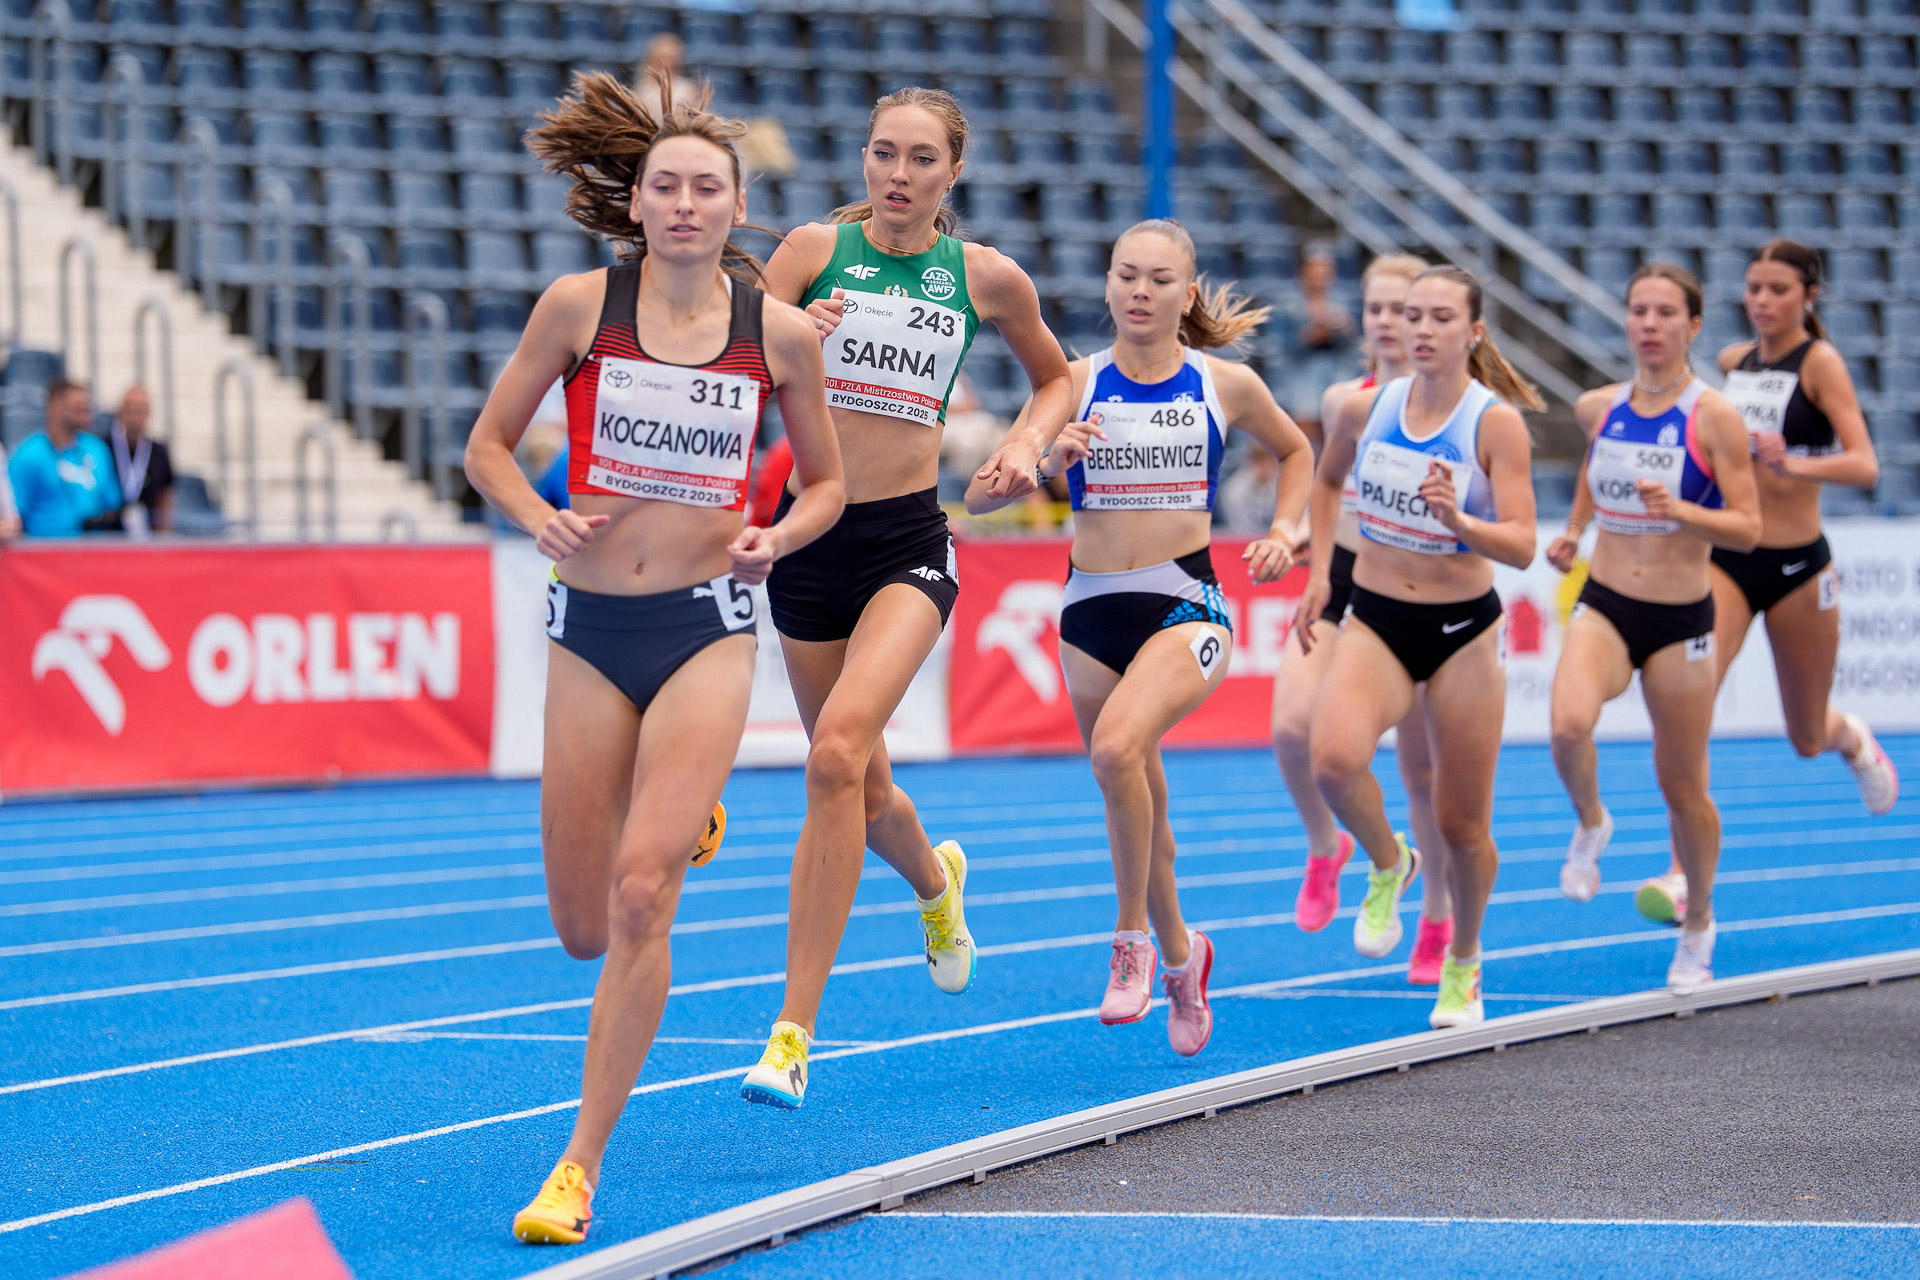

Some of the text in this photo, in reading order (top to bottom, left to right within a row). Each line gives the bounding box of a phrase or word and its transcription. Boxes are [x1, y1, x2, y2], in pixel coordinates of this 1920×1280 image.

[844, 264, 881, 280] 4F
[930, 272, 948, 281] AZS
[928, 284, 950, 294] AWF
[864, 306, 955, 338] Okęcie 243
[841, 338, 936, 380] SARNA
[690, 379, 743, 410] 311
[825, 378, 937, 409] 101. PZLA Mistrzostwa Polski
[831, 394, 929, 420] BYDGOSZCZ 2025
[1150, 409, 1195, 427] 486
[600, 412, 742, 460] KOCZANOWA
[1088, 442, 1203, 470] BEREŚNIEWICZ
[1635, 450, 1674, 470] 500
[599, 459, 737, 489] 101. PZLA Mistrzostwa Polski
[1125, 484, 1177, 493] Mistrzostwa
[1177, 482, 1201, 491] Polski
[606, 475, 722, 503] BYDGOSZCZ 2025
[1100, 495, 1192, 506] BYDGOSZCZ 2025
[908, 566, 944, 581] 4F
[727, 578, 753, 620] 5
[1162, 611, 1204, 627] adidas
[187, 612, 461, 707] ORLEN
[1200, 636, 1219, 667] 6
